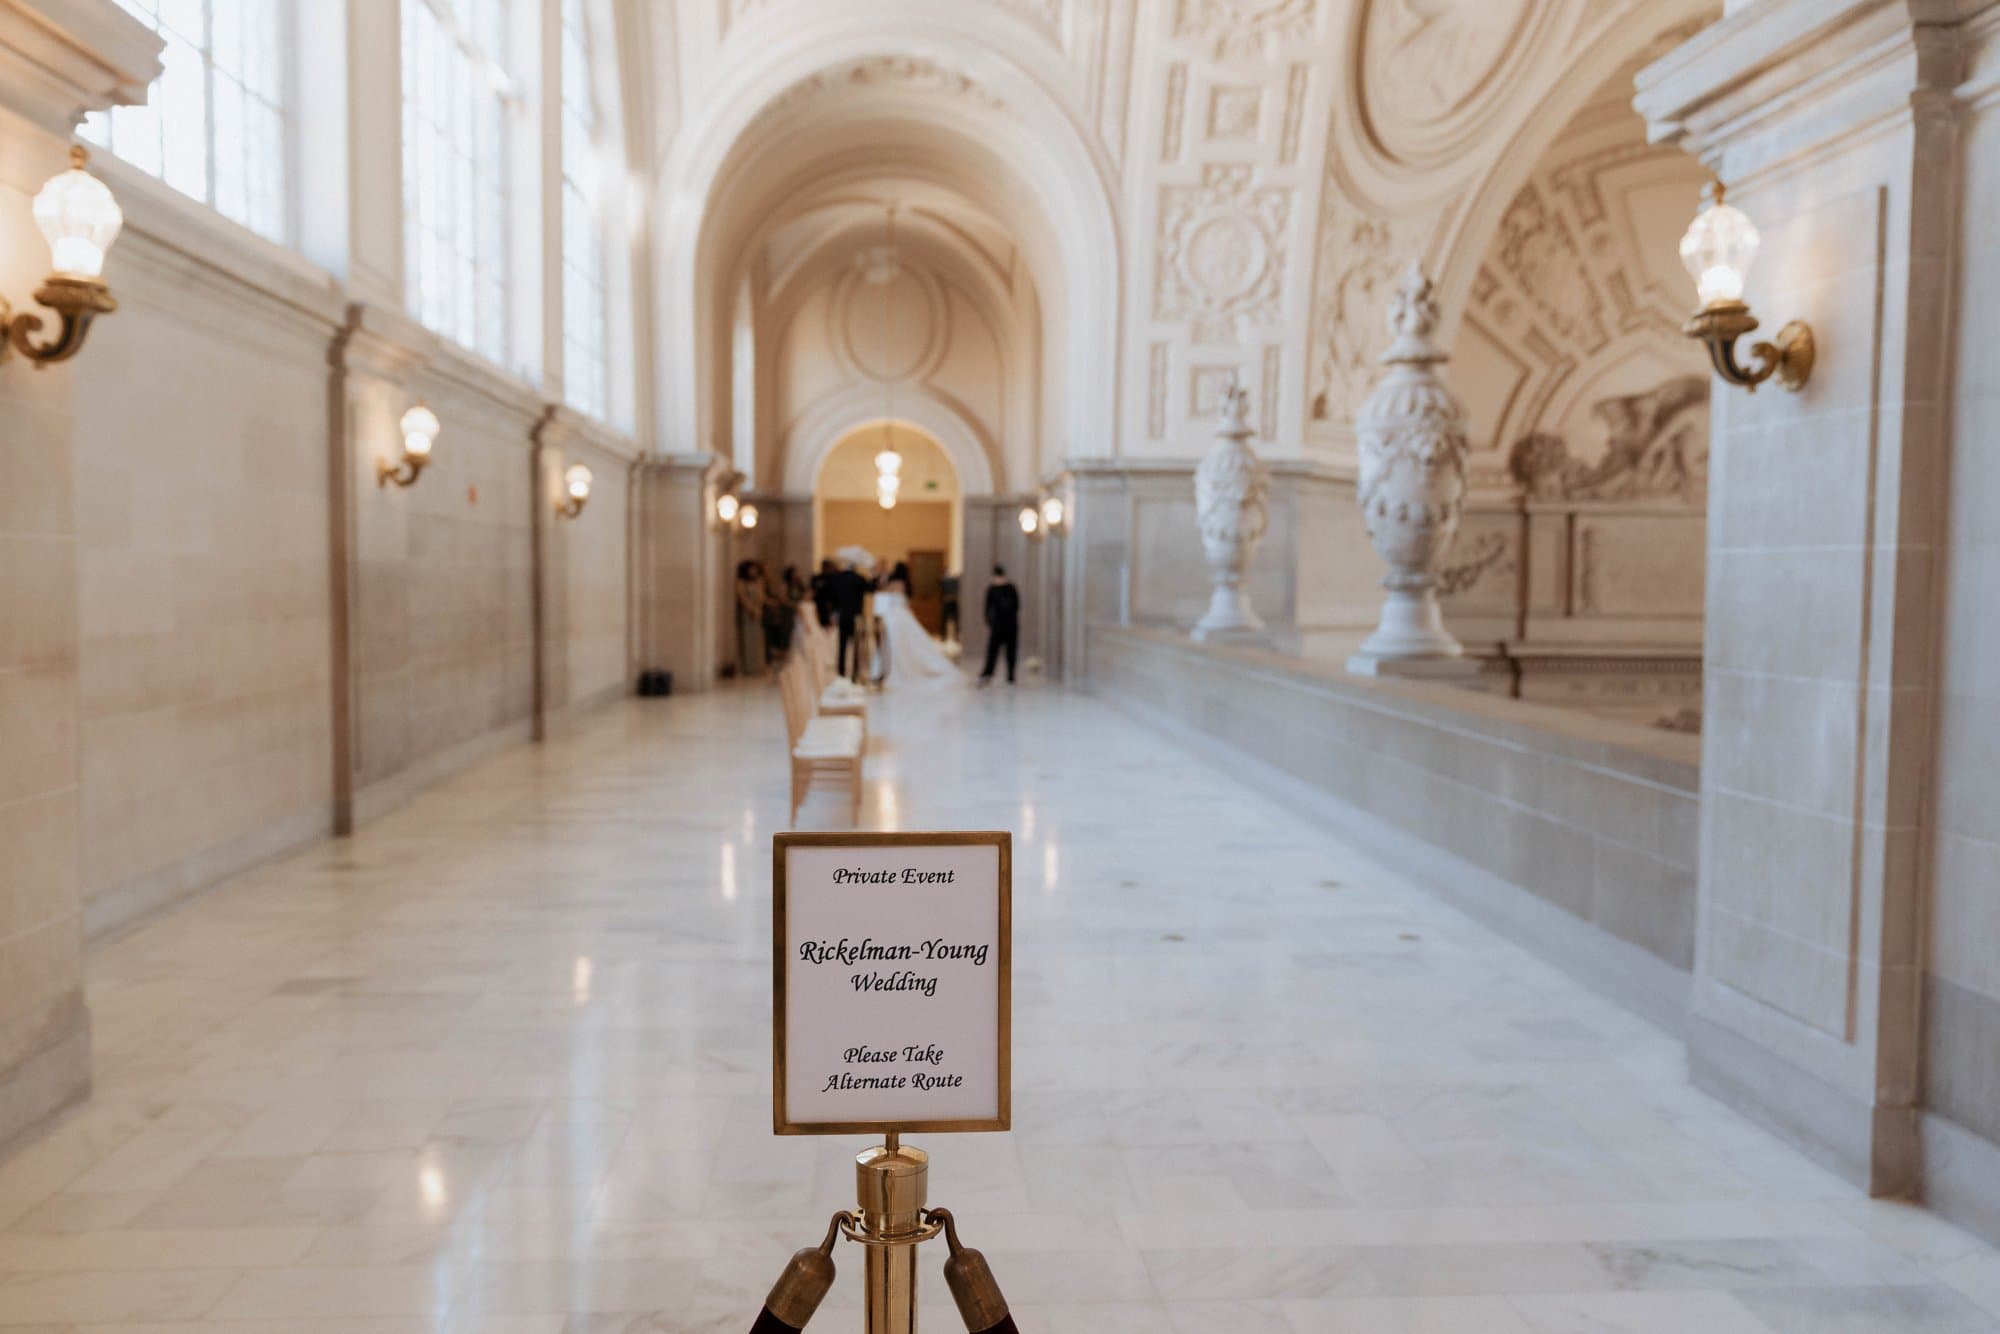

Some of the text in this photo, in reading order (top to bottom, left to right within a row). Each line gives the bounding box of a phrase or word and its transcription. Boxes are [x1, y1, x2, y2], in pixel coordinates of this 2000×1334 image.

[832, 867, 956, 885] Private Event
[799, 937, 989, 966] Rickelman-Young
[850, 970, 938, 997] Wedding
[843, 1043, 944, 1066] Please Take
[821, 1072, 963, 1093] Alternate Route
